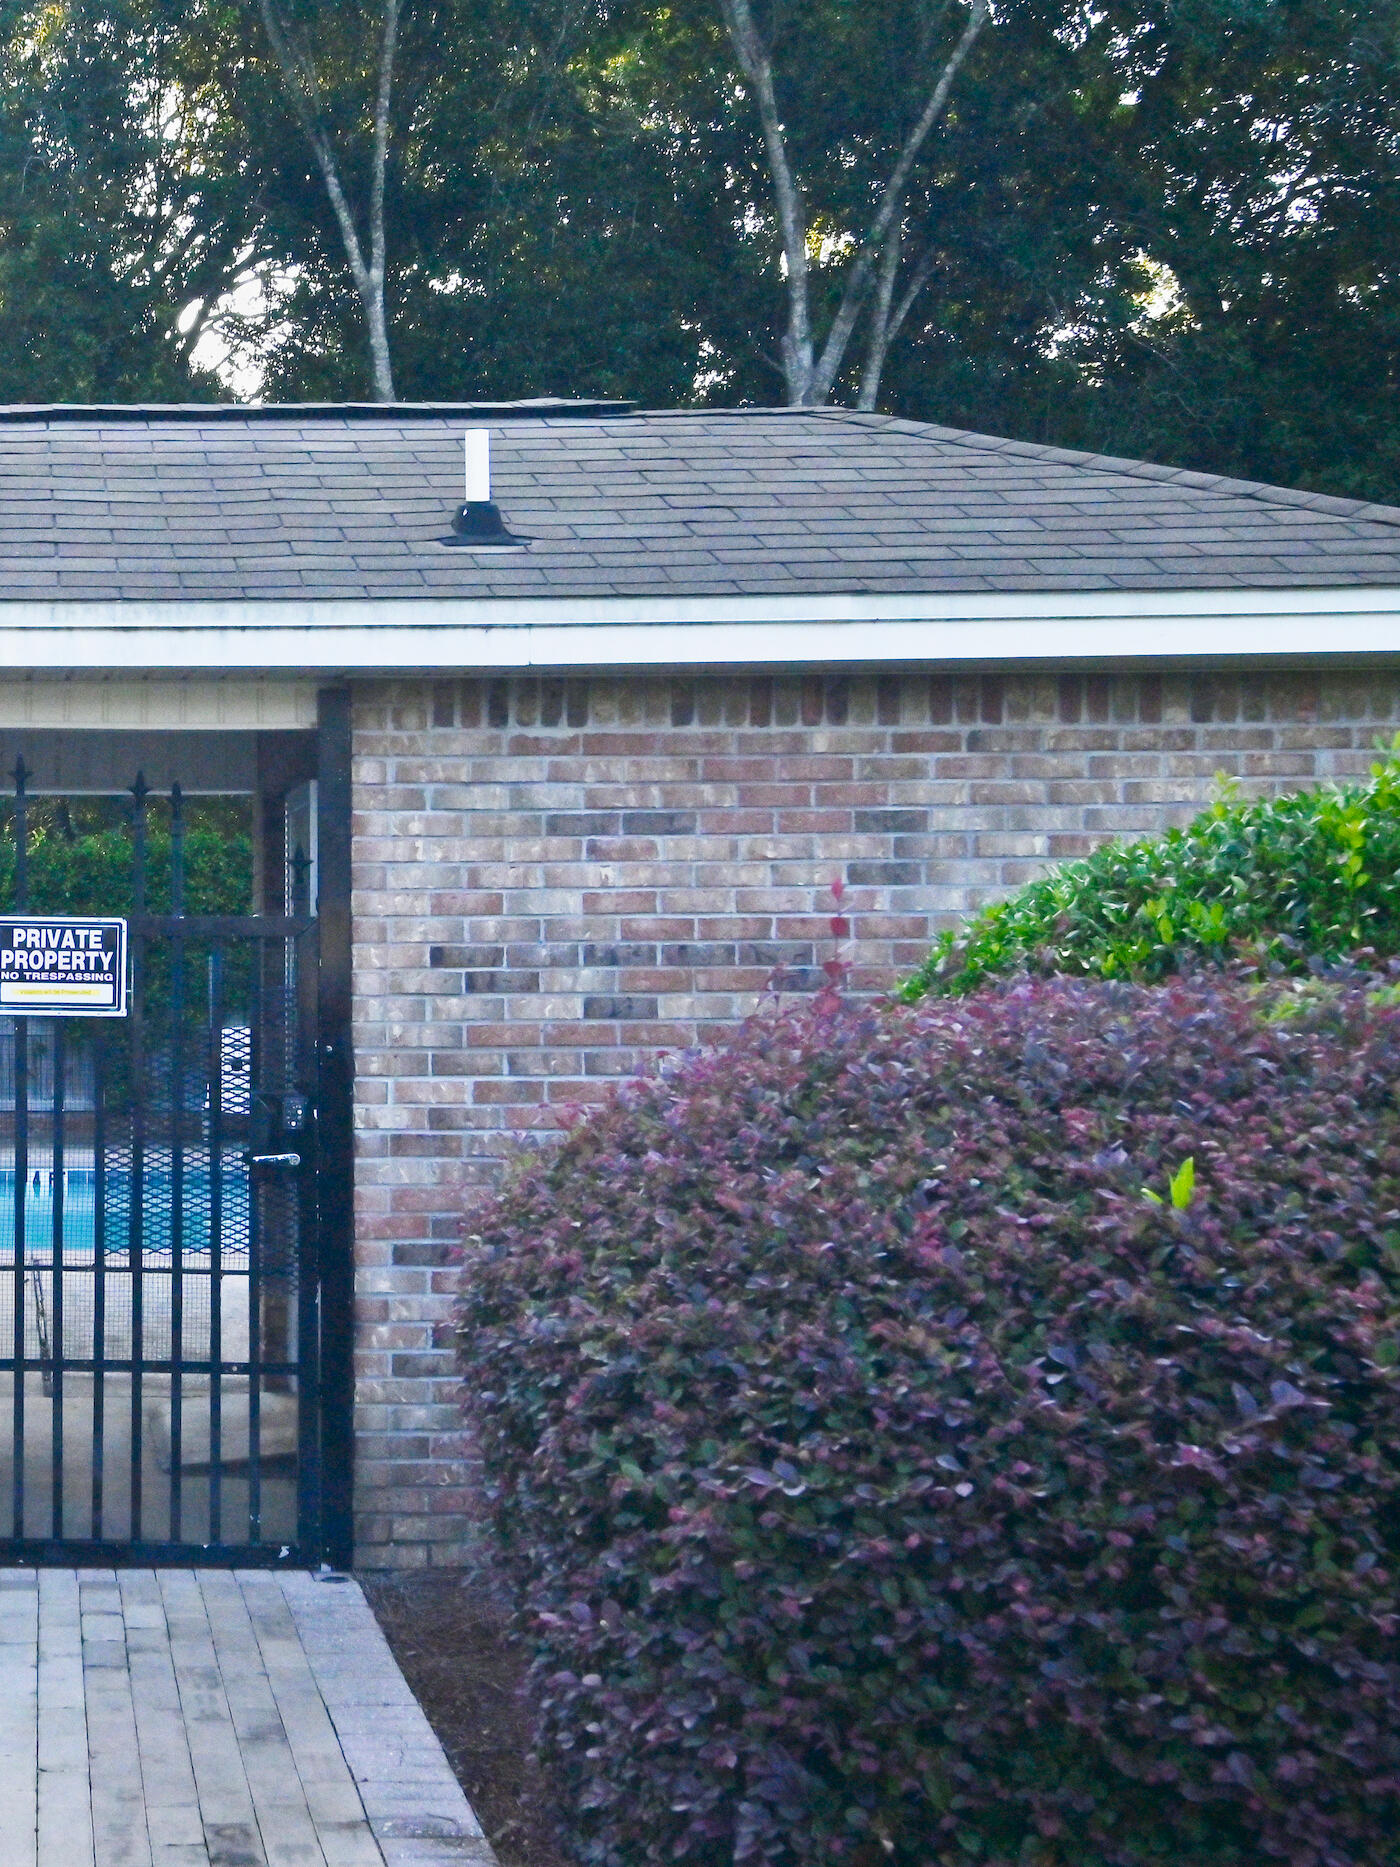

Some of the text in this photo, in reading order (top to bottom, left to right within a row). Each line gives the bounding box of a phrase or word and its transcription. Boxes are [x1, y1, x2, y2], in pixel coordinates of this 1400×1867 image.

[13, 928, 103, 949] PRIVATE
[1, 949, 114, 971] PROPERTY
[1, 971, 114, 982] NO TRESPASSING
